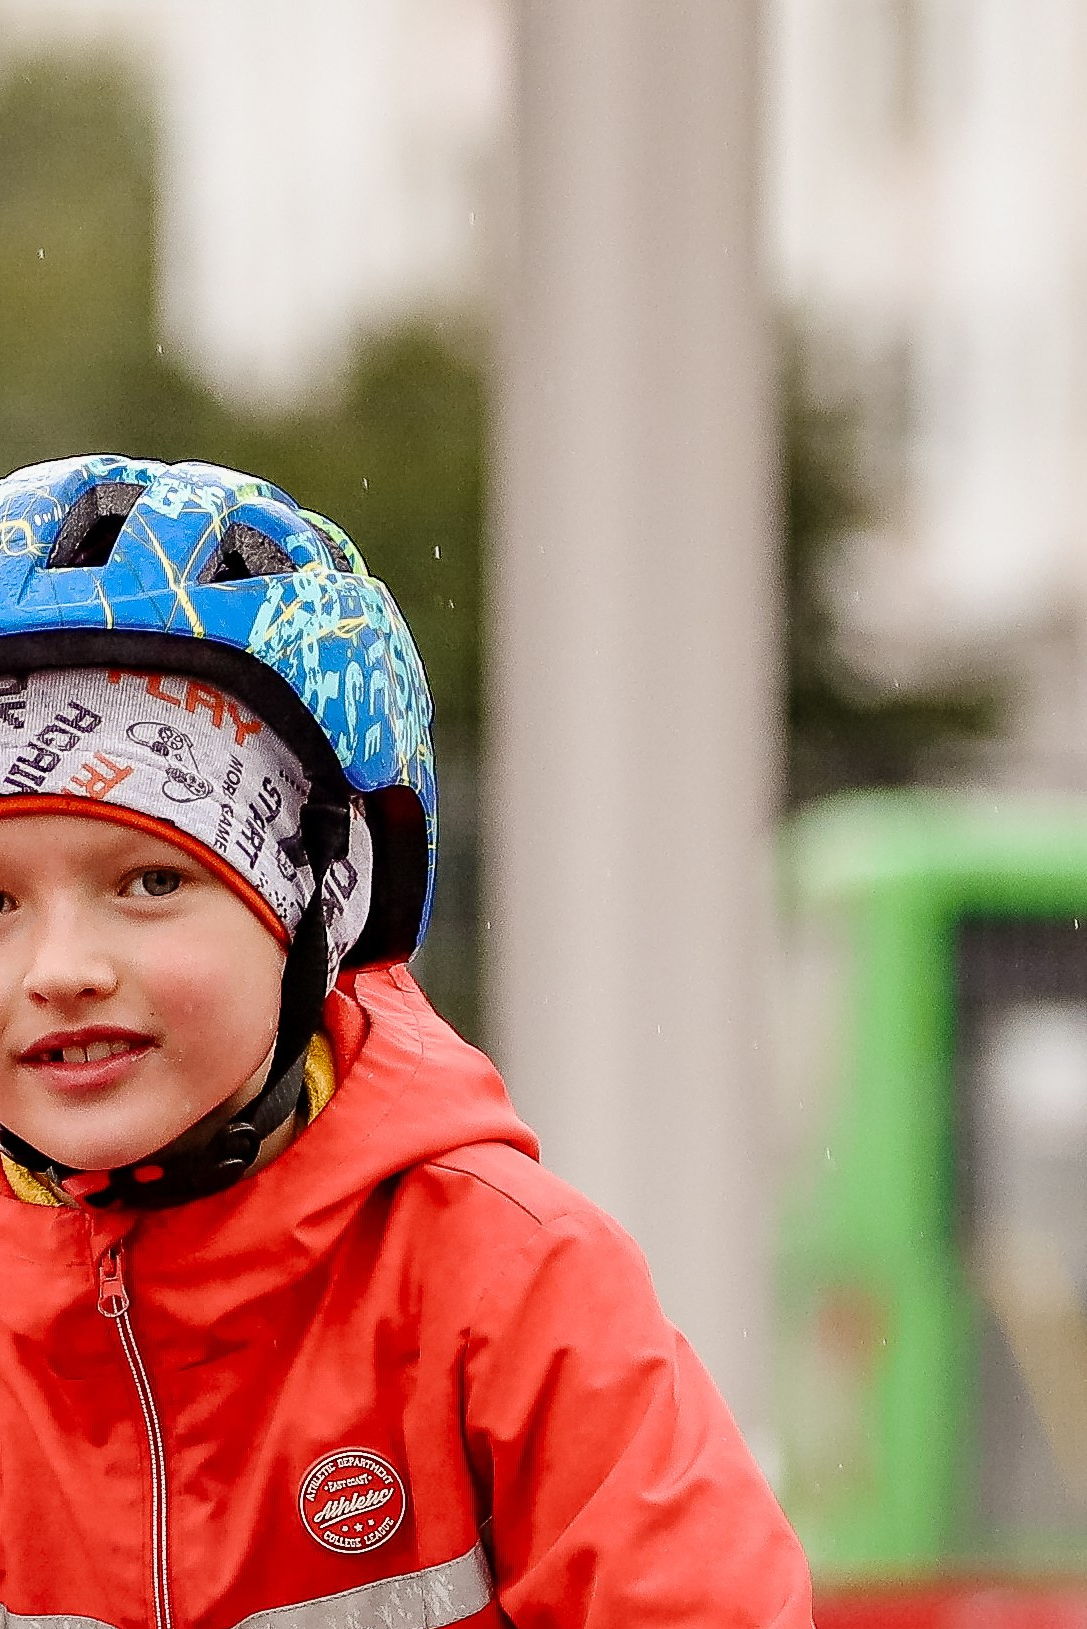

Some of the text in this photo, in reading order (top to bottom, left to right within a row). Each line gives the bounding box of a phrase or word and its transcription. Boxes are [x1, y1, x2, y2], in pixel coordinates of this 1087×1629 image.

[61, 750, 135, 800] TR
[234, 776, 283, 870] START
[305, 1456, 394, 1502] ATHLETIC DEPARTMENT
[314, 1487, 394, 1524] Athletic
[323, 1516, 394, 1548] COLLEGE LEAGUE
